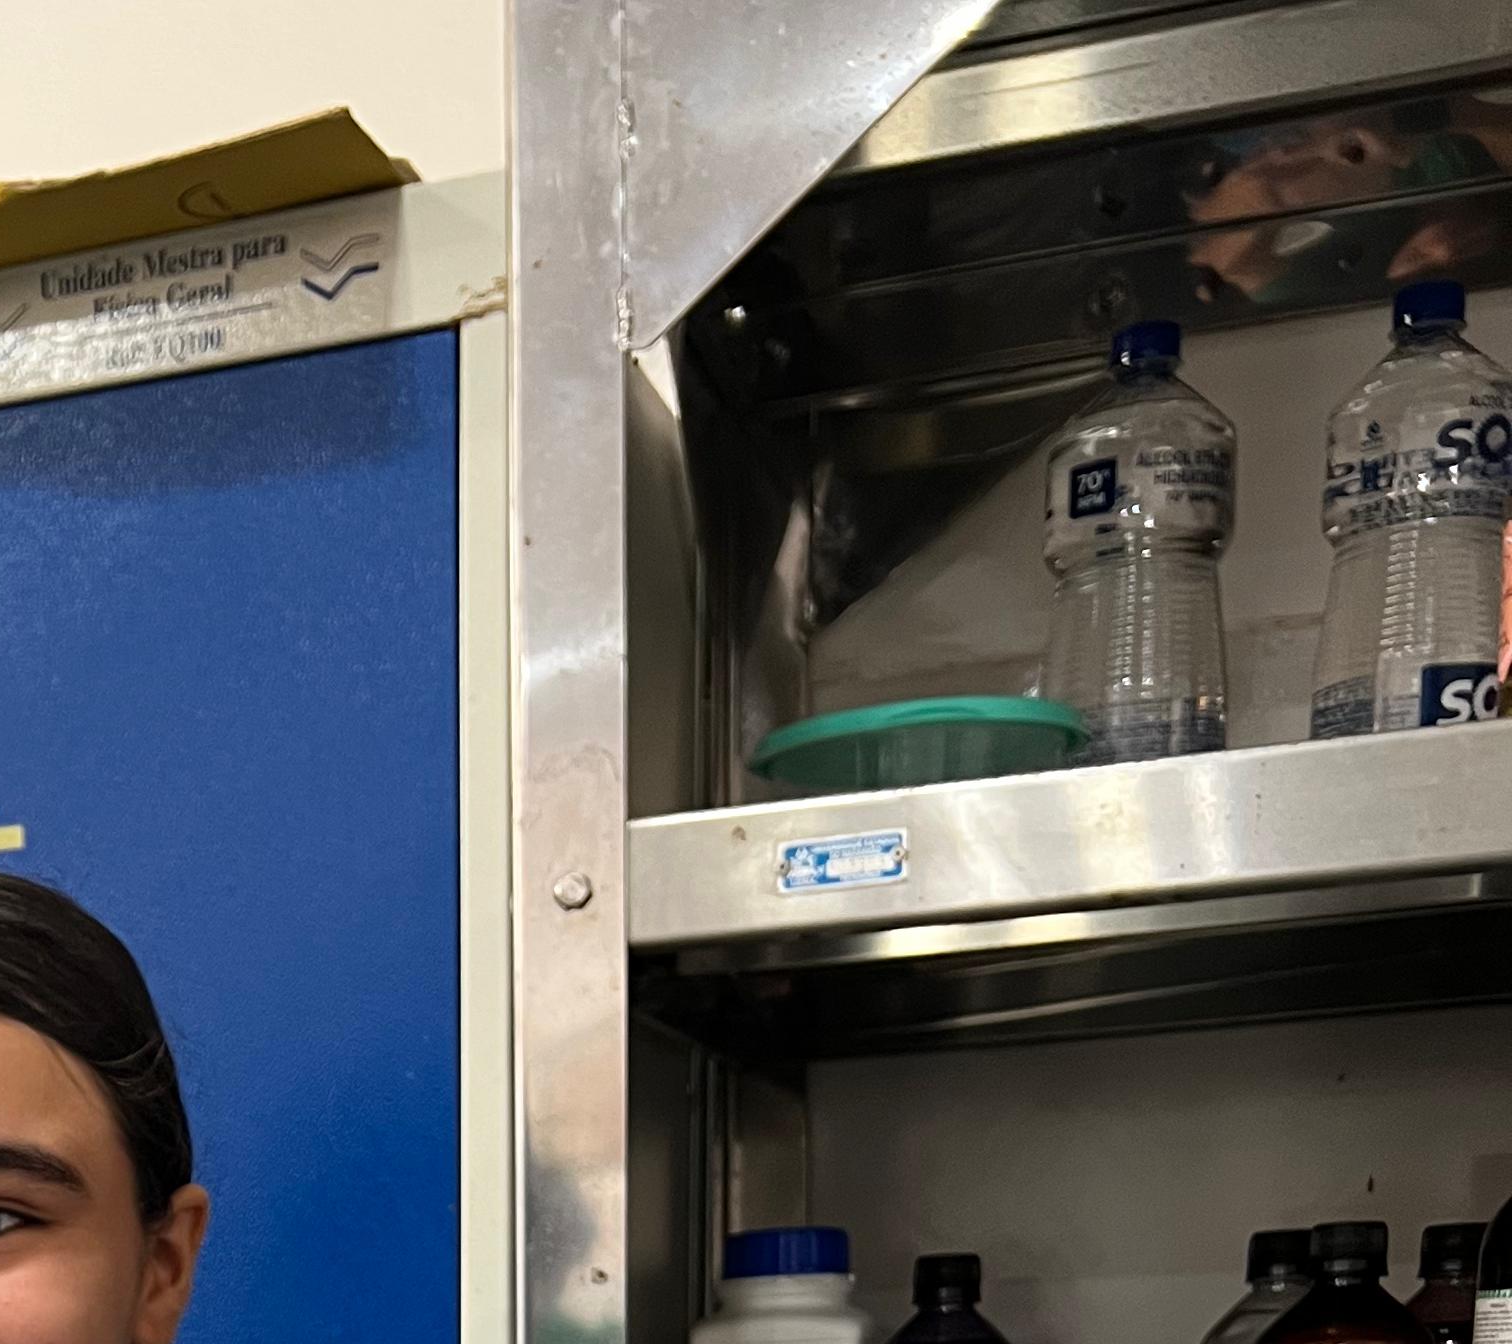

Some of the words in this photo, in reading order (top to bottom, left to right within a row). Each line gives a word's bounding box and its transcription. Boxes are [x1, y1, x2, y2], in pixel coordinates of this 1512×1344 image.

[40, 258, 135, 300] Unidade
[142, 246, 223, 281] Mestra
[231, 234, 287, 270] para
